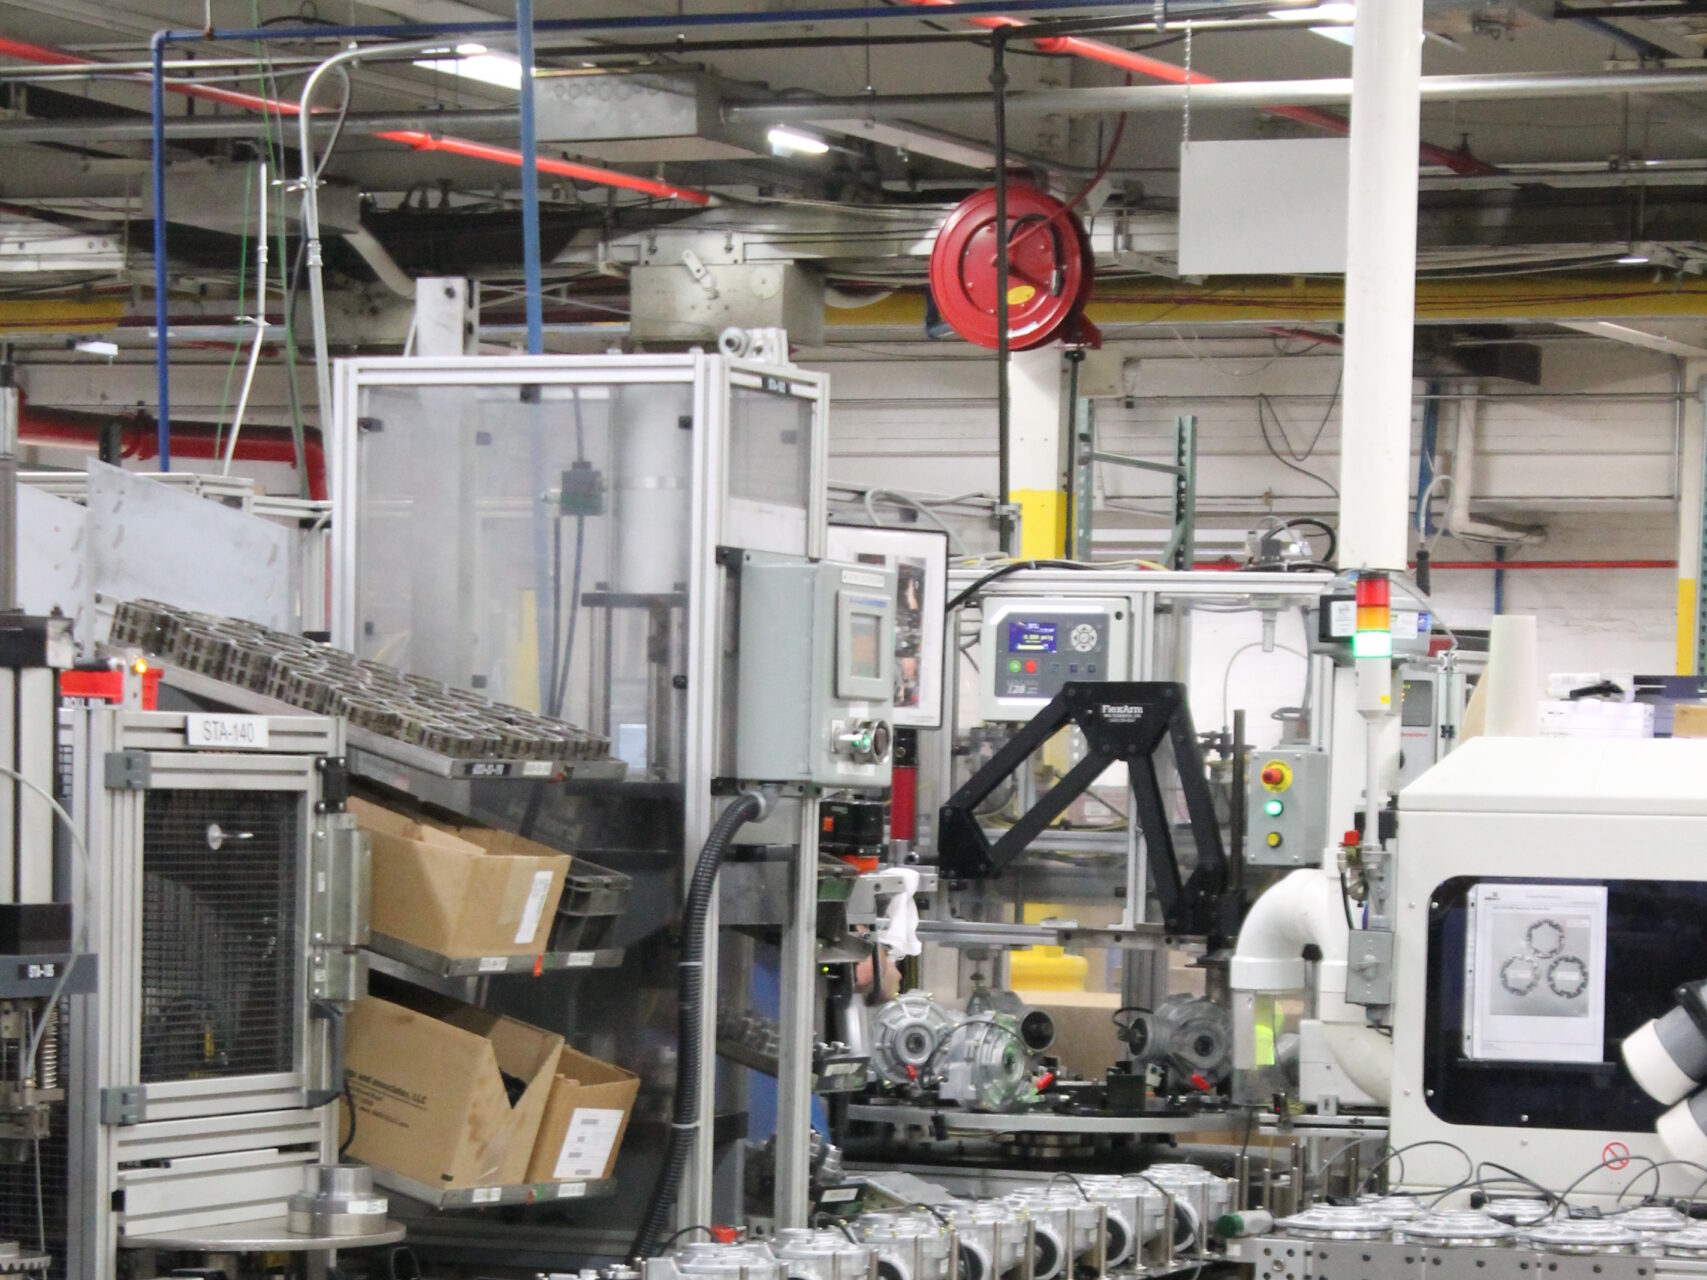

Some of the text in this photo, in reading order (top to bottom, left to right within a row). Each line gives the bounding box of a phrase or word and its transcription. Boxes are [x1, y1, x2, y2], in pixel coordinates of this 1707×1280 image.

[1102, 704, 1144, 714] FlexArm
[203, 720, 255, 743] STA-140
[411, 1092, 427, 1104] LLC
